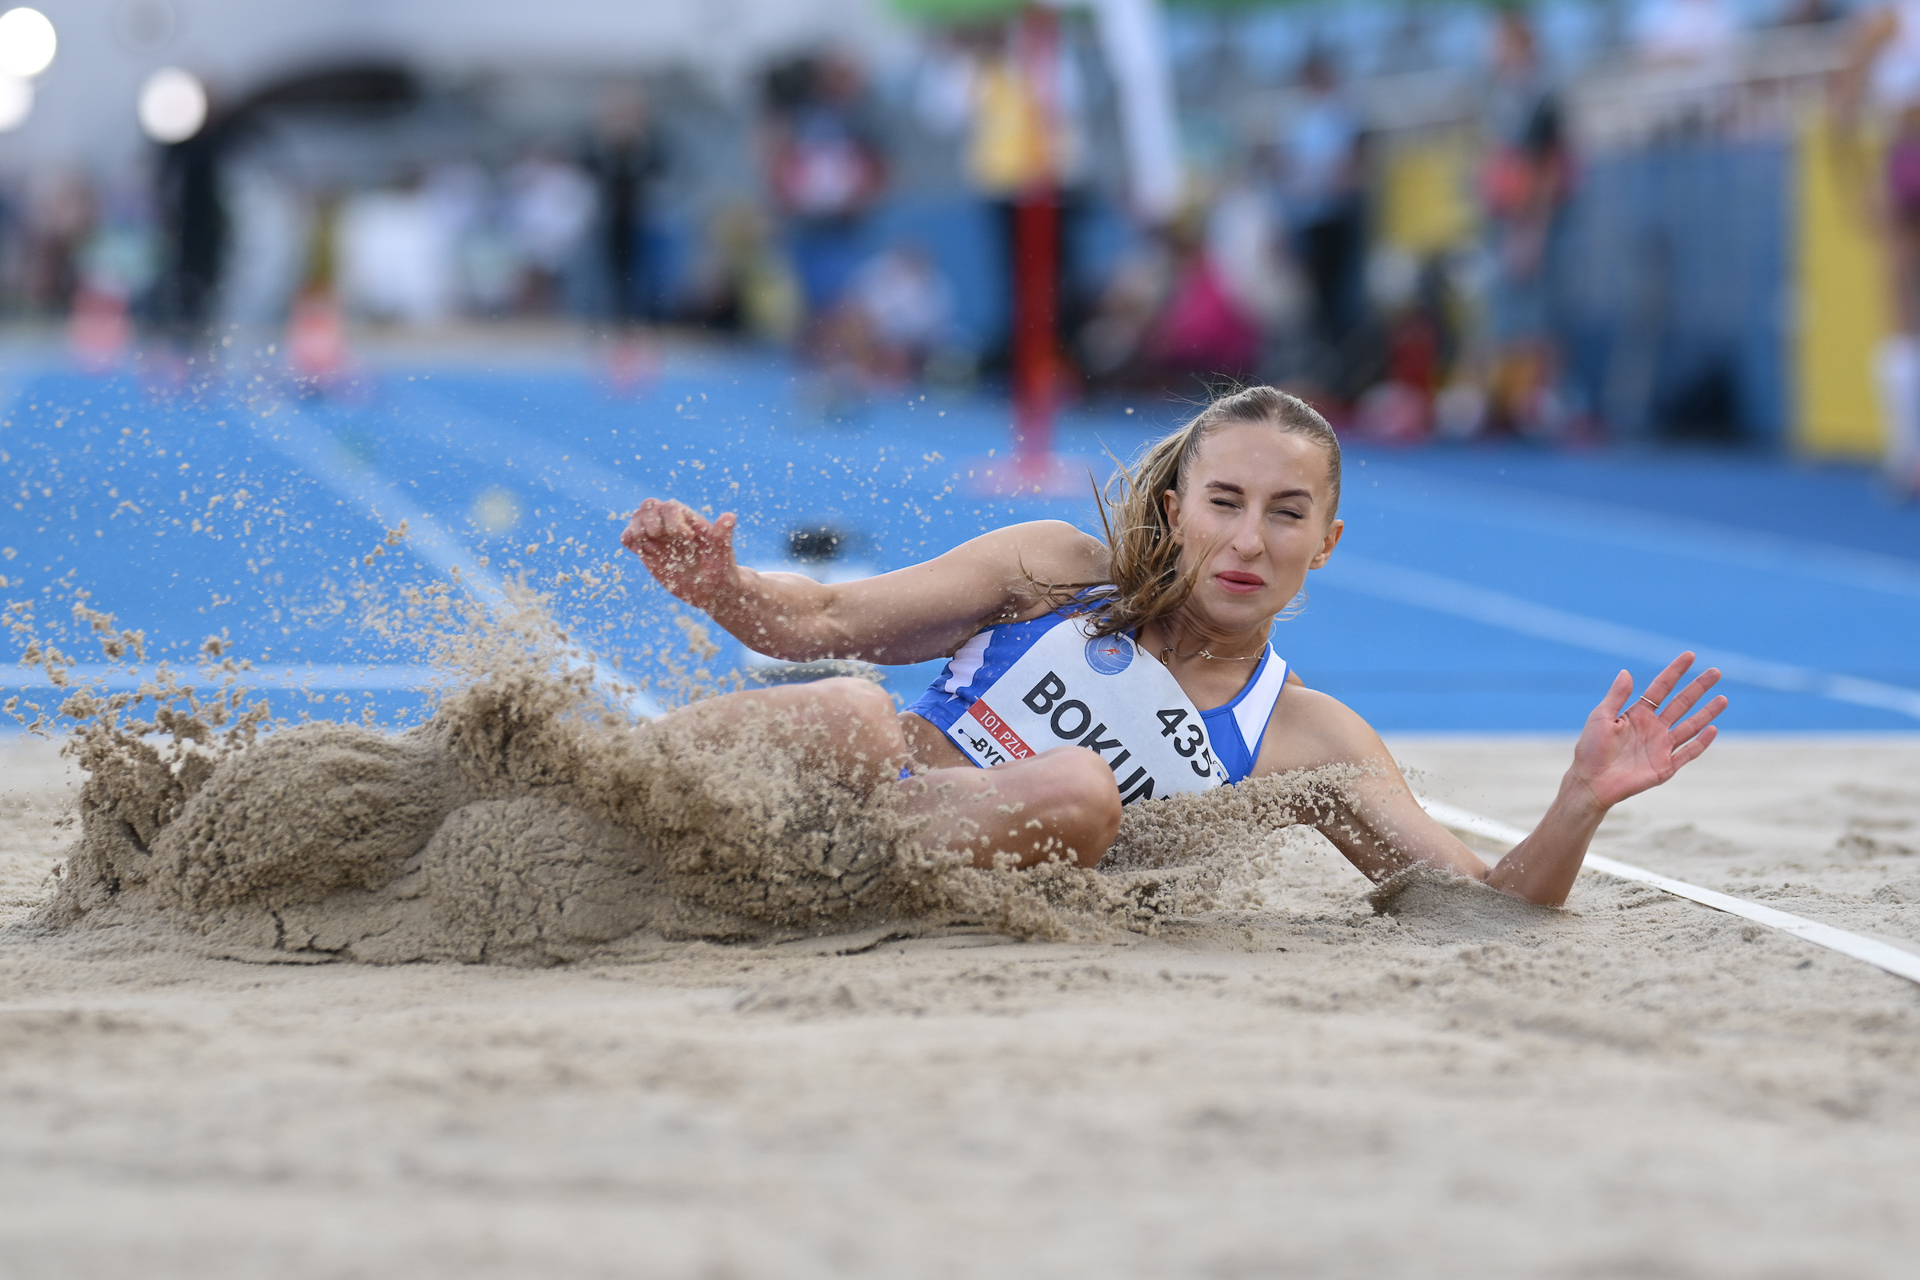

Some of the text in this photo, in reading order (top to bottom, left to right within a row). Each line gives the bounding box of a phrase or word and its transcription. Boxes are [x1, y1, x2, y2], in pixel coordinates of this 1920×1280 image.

[980, 710, 1029, 760] 101. PZLA
[1156, 708, 1212, 778] 435
